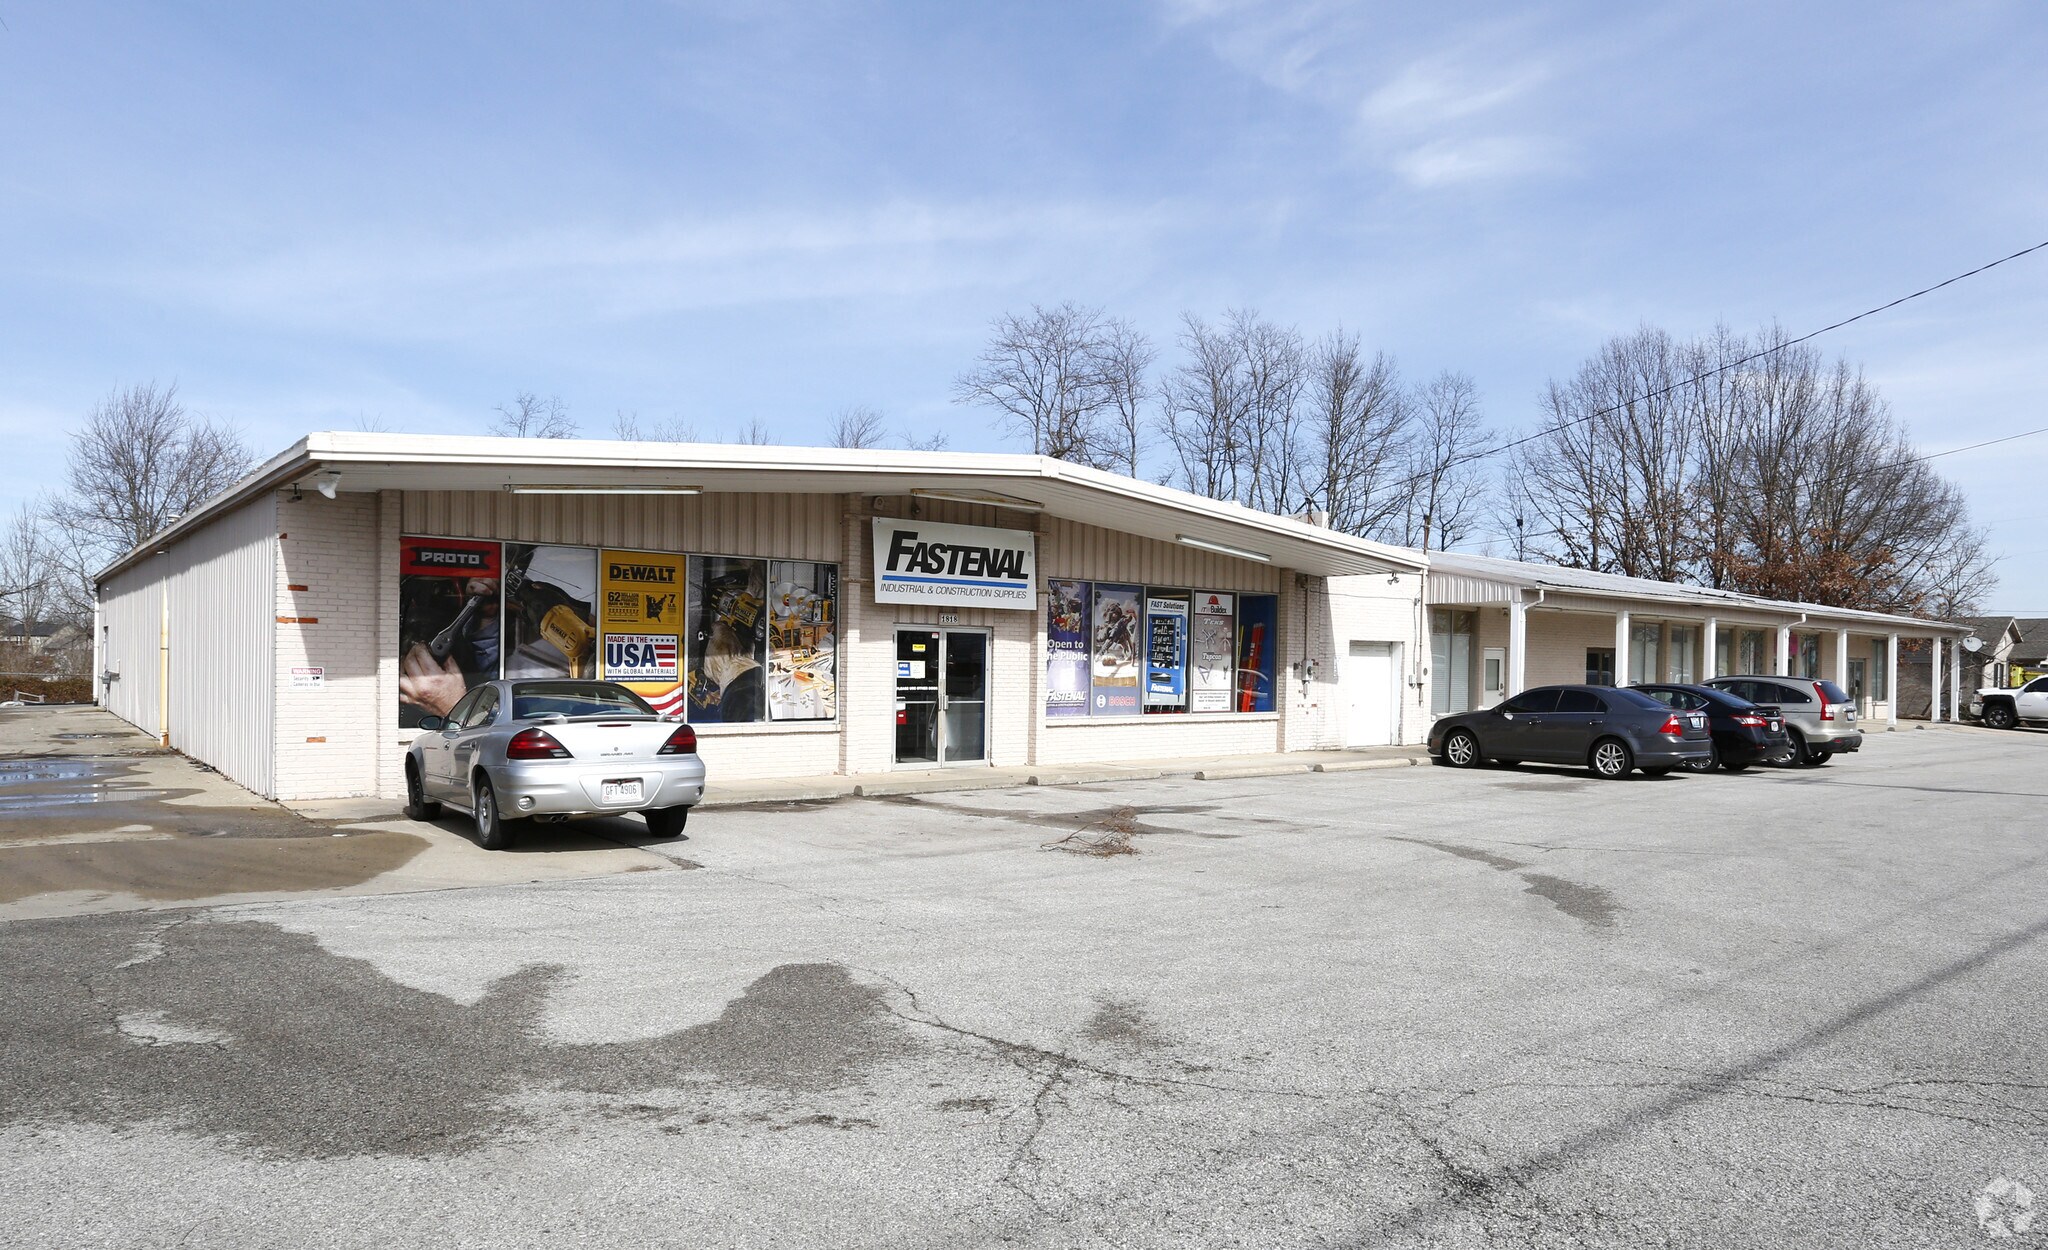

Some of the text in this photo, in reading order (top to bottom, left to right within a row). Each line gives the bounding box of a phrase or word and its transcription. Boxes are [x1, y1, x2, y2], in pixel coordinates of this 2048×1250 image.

[421, 551, 480, 565] PROTO
[886, 530, 1029, 580] FASTENAL
[607, 591, 620, 602] 62
[880, 583, 1027, 599] INDUSTRIAL & CONSTRUCTION SUPPLIES
[668, 594, 676, 604] 7
[1150, 600, 1185, 610] FAST Solutions
[941, 615, 958, 623] 1818
[1047, 639, 1084, 651] Open to
[607, 643, 657, 668] USA
[1047, 651, 1088, 661] he Public
[1046, 689, 1086, 702] FASTENAL
[1108, 696, 1136, 706] BOSCH
